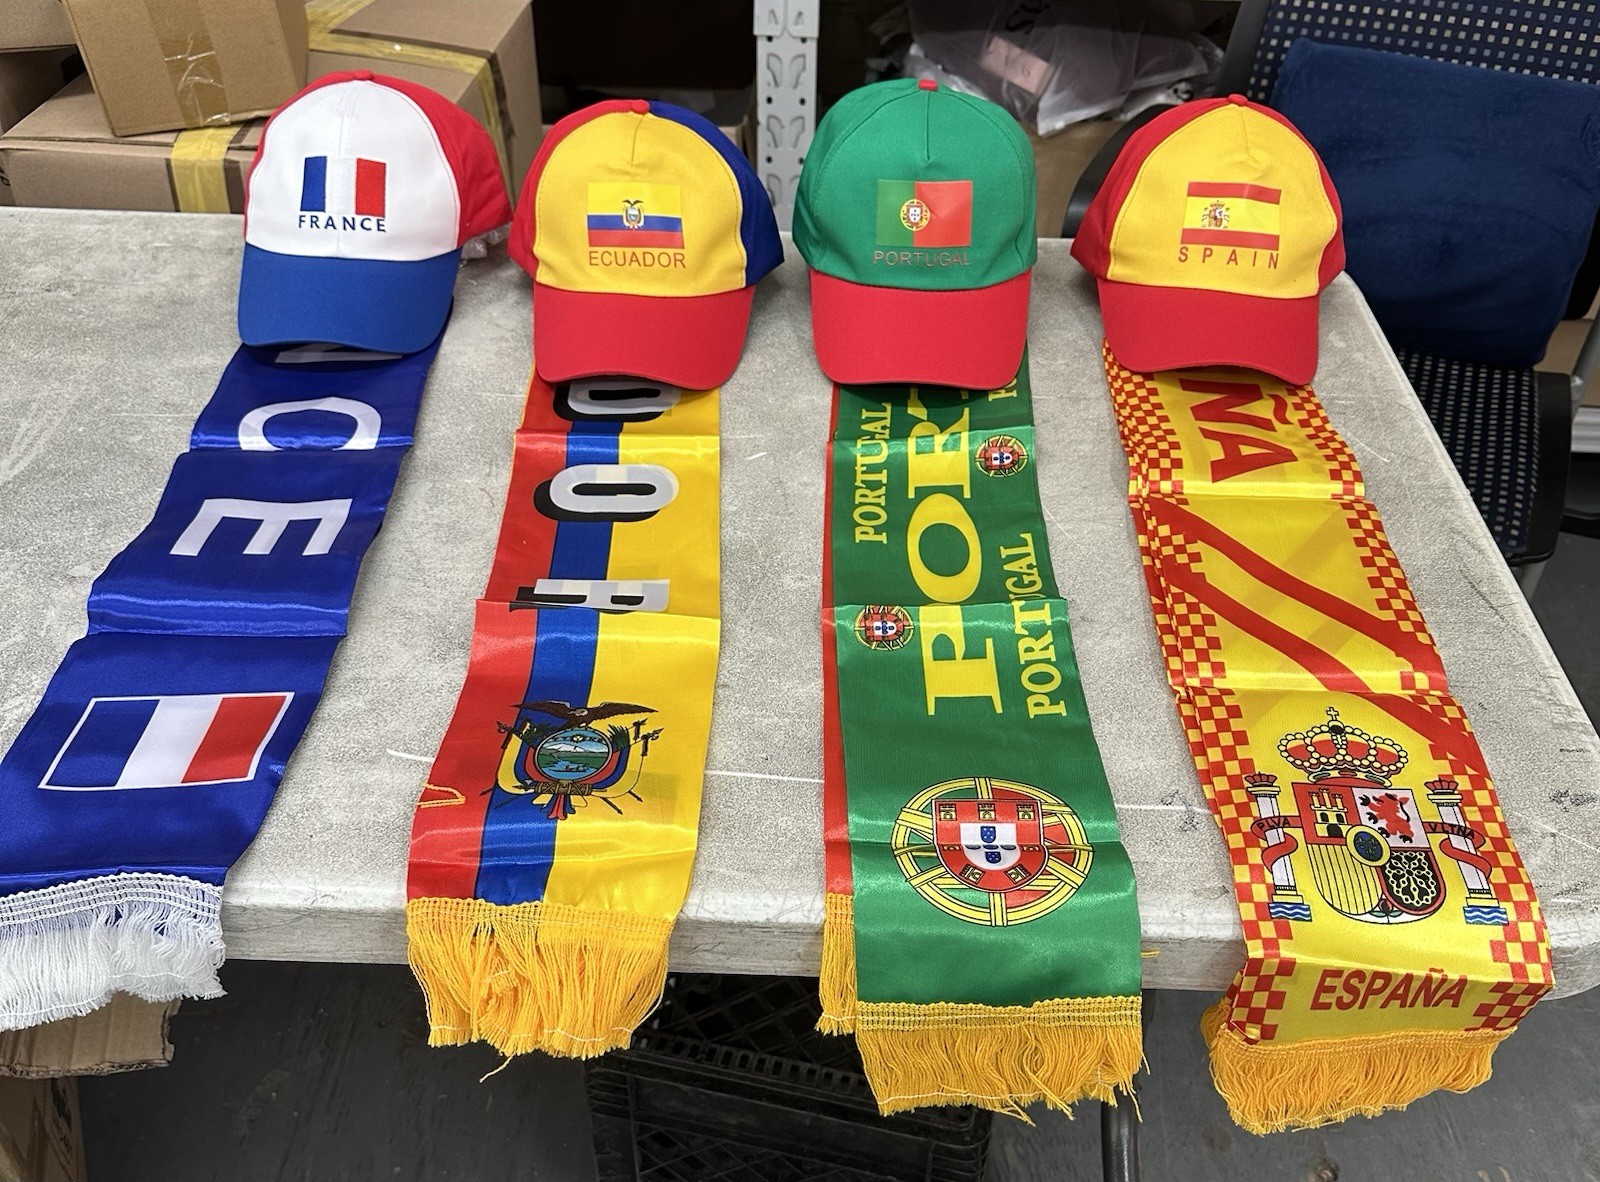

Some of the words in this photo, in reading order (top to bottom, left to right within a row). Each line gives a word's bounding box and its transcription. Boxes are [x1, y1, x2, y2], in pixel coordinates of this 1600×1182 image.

[298, 214, 387, 233] FRANCE
[588, 250, 686, 269] ECUADOR
[871, 250, 971, 267] PORTUGAL
[1177, 245, 1280, 270] SPAIN
[1000, 532, 1067, 719] PORTGAL
[1309, 967, 1468, 1011] ESPAÑA
